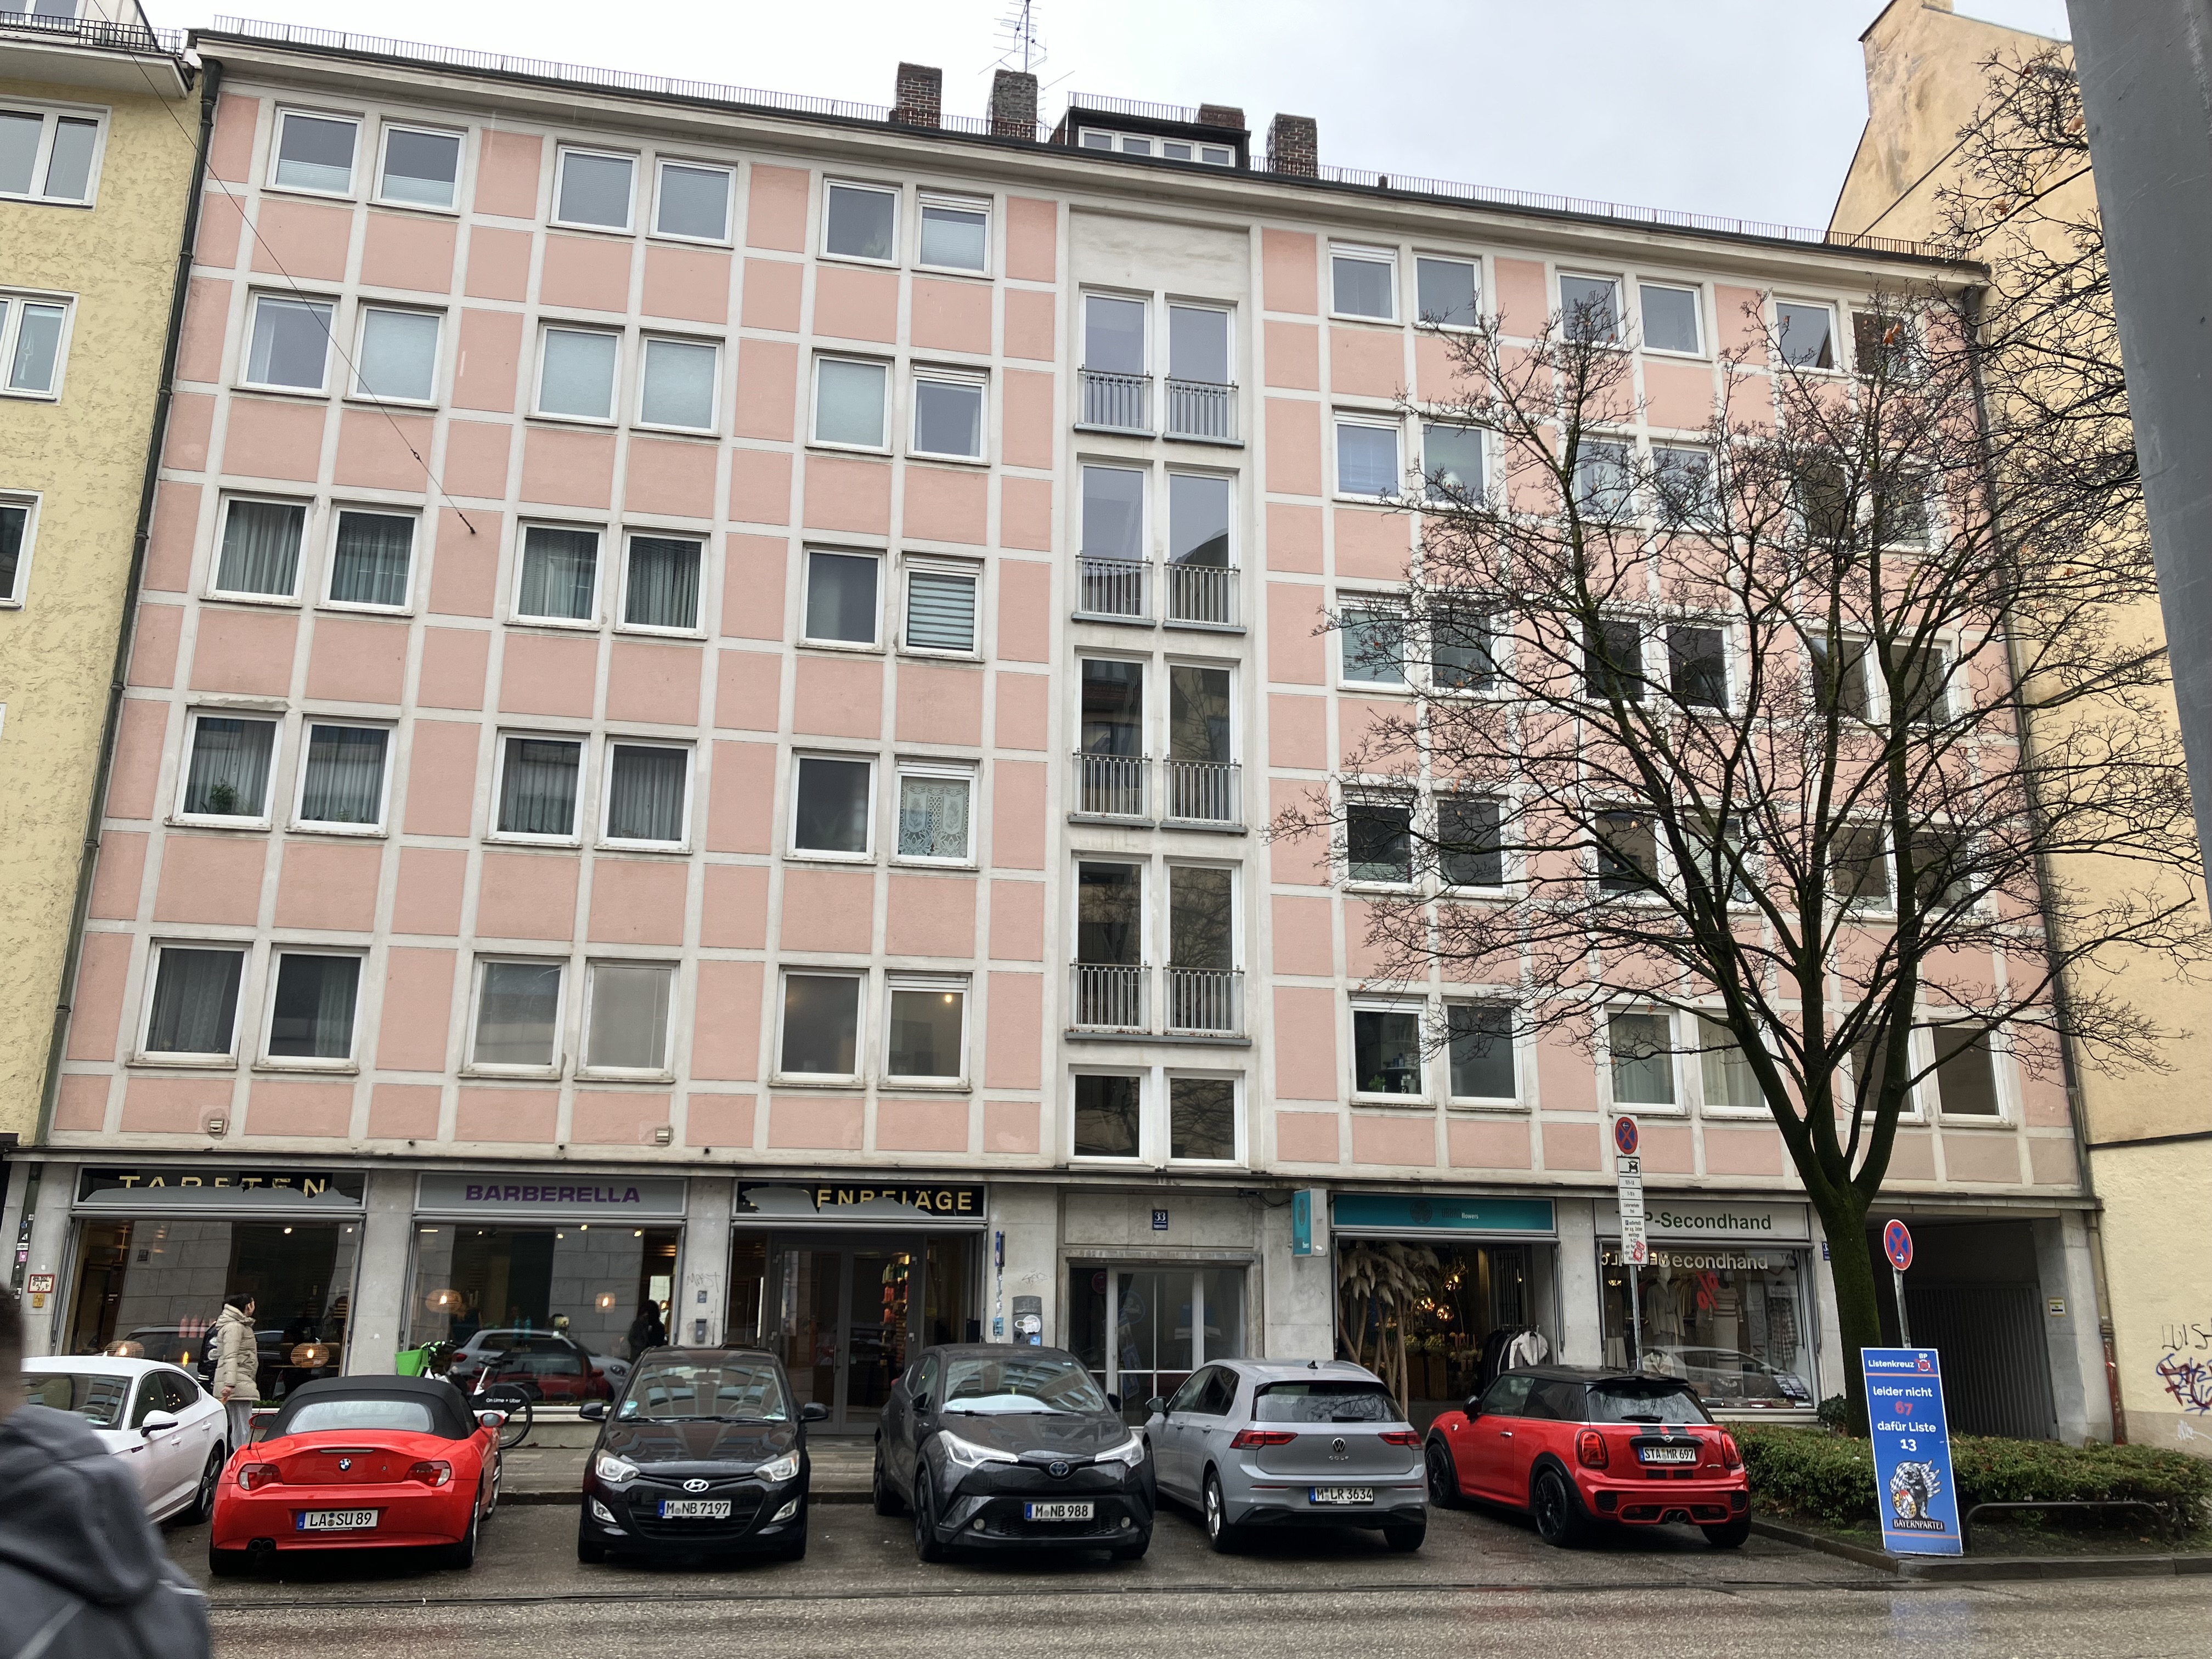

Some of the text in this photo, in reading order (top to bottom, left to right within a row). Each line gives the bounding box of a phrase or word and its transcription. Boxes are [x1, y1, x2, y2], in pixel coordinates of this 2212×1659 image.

[465, 1185, 640, 1203] BARBERELLA
[749, 1189, 972, 1210] ENBELÄGE
[1154, 1211, 1166, 1221] 33
[1615, 1211, 1772, 1230] P-Secondhand
[1658, 1251, 1768, 1270] Secondhand
[1873, 1386, 1933, 1397] leider nicht
[1895, 1401, 1914, 1416] 67
[1877, 1421, 1936, 1432] dafür Liste
[1900, 1438, 1917, 1452] 13
[1645, 1448, 1694, 1459] STA MR 697
[1317, 1488, 1372, 1499] M LR 3634
[667, 1503, 730, 1514] M NB 7197
[1036, 1505, 1088, 1517] M NB 988
[310, 1514, 326, 1526] LA
[336, 1513, 353, 1526] SU
[356, 1513, 372, 1525] 89
[1894, 1519, 1943, 1530] BAYERNPARTEI
